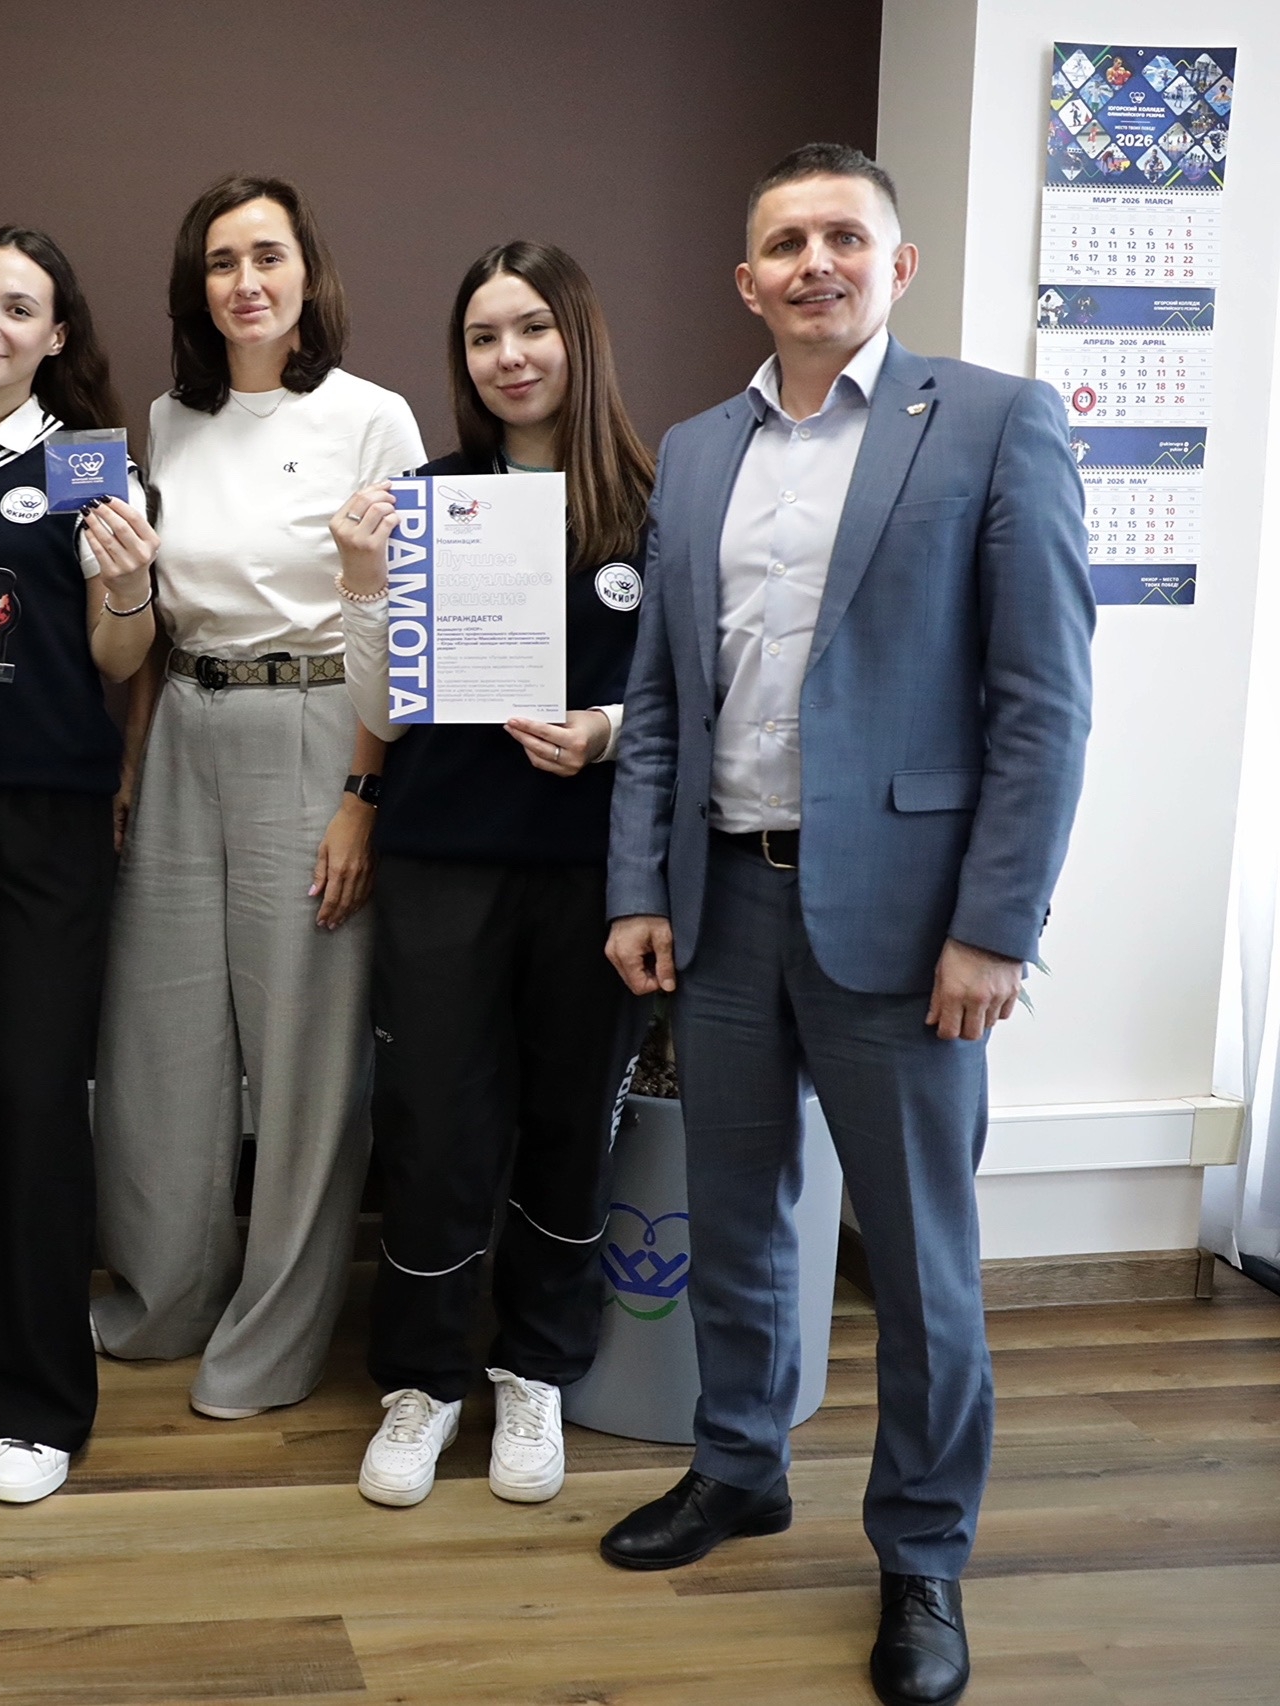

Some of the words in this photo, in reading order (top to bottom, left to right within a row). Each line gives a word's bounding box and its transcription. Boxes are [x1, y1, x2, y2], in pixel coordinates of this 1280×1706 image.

[1116, 134, 1154, 147] 2026
[1088, 240, 1098, 248] 10
[1108, 240, 1118, 248] 11
[1126, 242, 1136, 250] 12
[1146, 242, 1156, 250] 13
[1184, 242, 1194, 250] 15
[1068, 254, 1080, 262] 16
[1088, 254, 1098, 262] 17
[1108, 254, 1118, 262] 18
[1126, 254, 1136, 262] 19
[1144, 254, 1156, 264] 20
[1164, 256, 1174, 264] 21
[1184, 256, 1194, 264] 22
[1106, 268, 1118, 276] 25
[1126, 268, 1136, 276] 26
[1144, 268, 1156, 276] 27
[1164, 268, 1174, 276] 28
[1184, 268, 1194, 278] 29
[1138, 368, 1148, 376] 10
[1176, 368, 1186, 376] 12
[1062, 382, 1072, 390] 13
[1098, 382, 1108, 390] 15
[1118, 382, 1128, 390] 16
[1136, 382, 1146, 390] 17
[1156, 382, 1166, 390] 18
[1176, 382, 1186, 390] 19
[1098, 396, 1108, 404] 22
[1116, 396, 1126, 404] 23
[1136, 396, 1146, 404] 24
[1154, 396, 1166, 404] 25
[1174, 396, 1184, 404] 26
[1096, 408, 1106, 416] 29
[1116, 408, 1126, 416] 30
[6, 508, 39, 519] ЮКИОР
[1166, 508, 1176, 516] 10
[1090, 520, 1100, 528] 13
[1108, 520, 1118, 528] 14
[1128, 520, 1138, 528] 15
[1146, 520, 1156, 528] 16
[1164, 520, 1174, 528] 17
[1088, 534, 1100, 542] 20
[1108, 534, 1116, 542] 21
[1126, 534, 1136, 542] 22
[1144, 534, 1154, 542] 23
[1164, 534, 1174, 542] 24
[1088, 546, 1098, 554] 27
[1106, 546, 1118, 554] 28
[1126, 546, 1136, 554] 29
[1144, 546, 1154, 554] 30
[1164, 546, 1174, 554] 31
[436, 550, 517, 571] Лучшее
[437, 572, 552, 590] визуальное
[388, 480, 428, 720] ГРАМОТА
[604, 587, 635, 603] ЮКИОР
[437, 592, 527, 611] решение
[436, 615, 502, 623] НАГРАЖДАЕТСЯ
